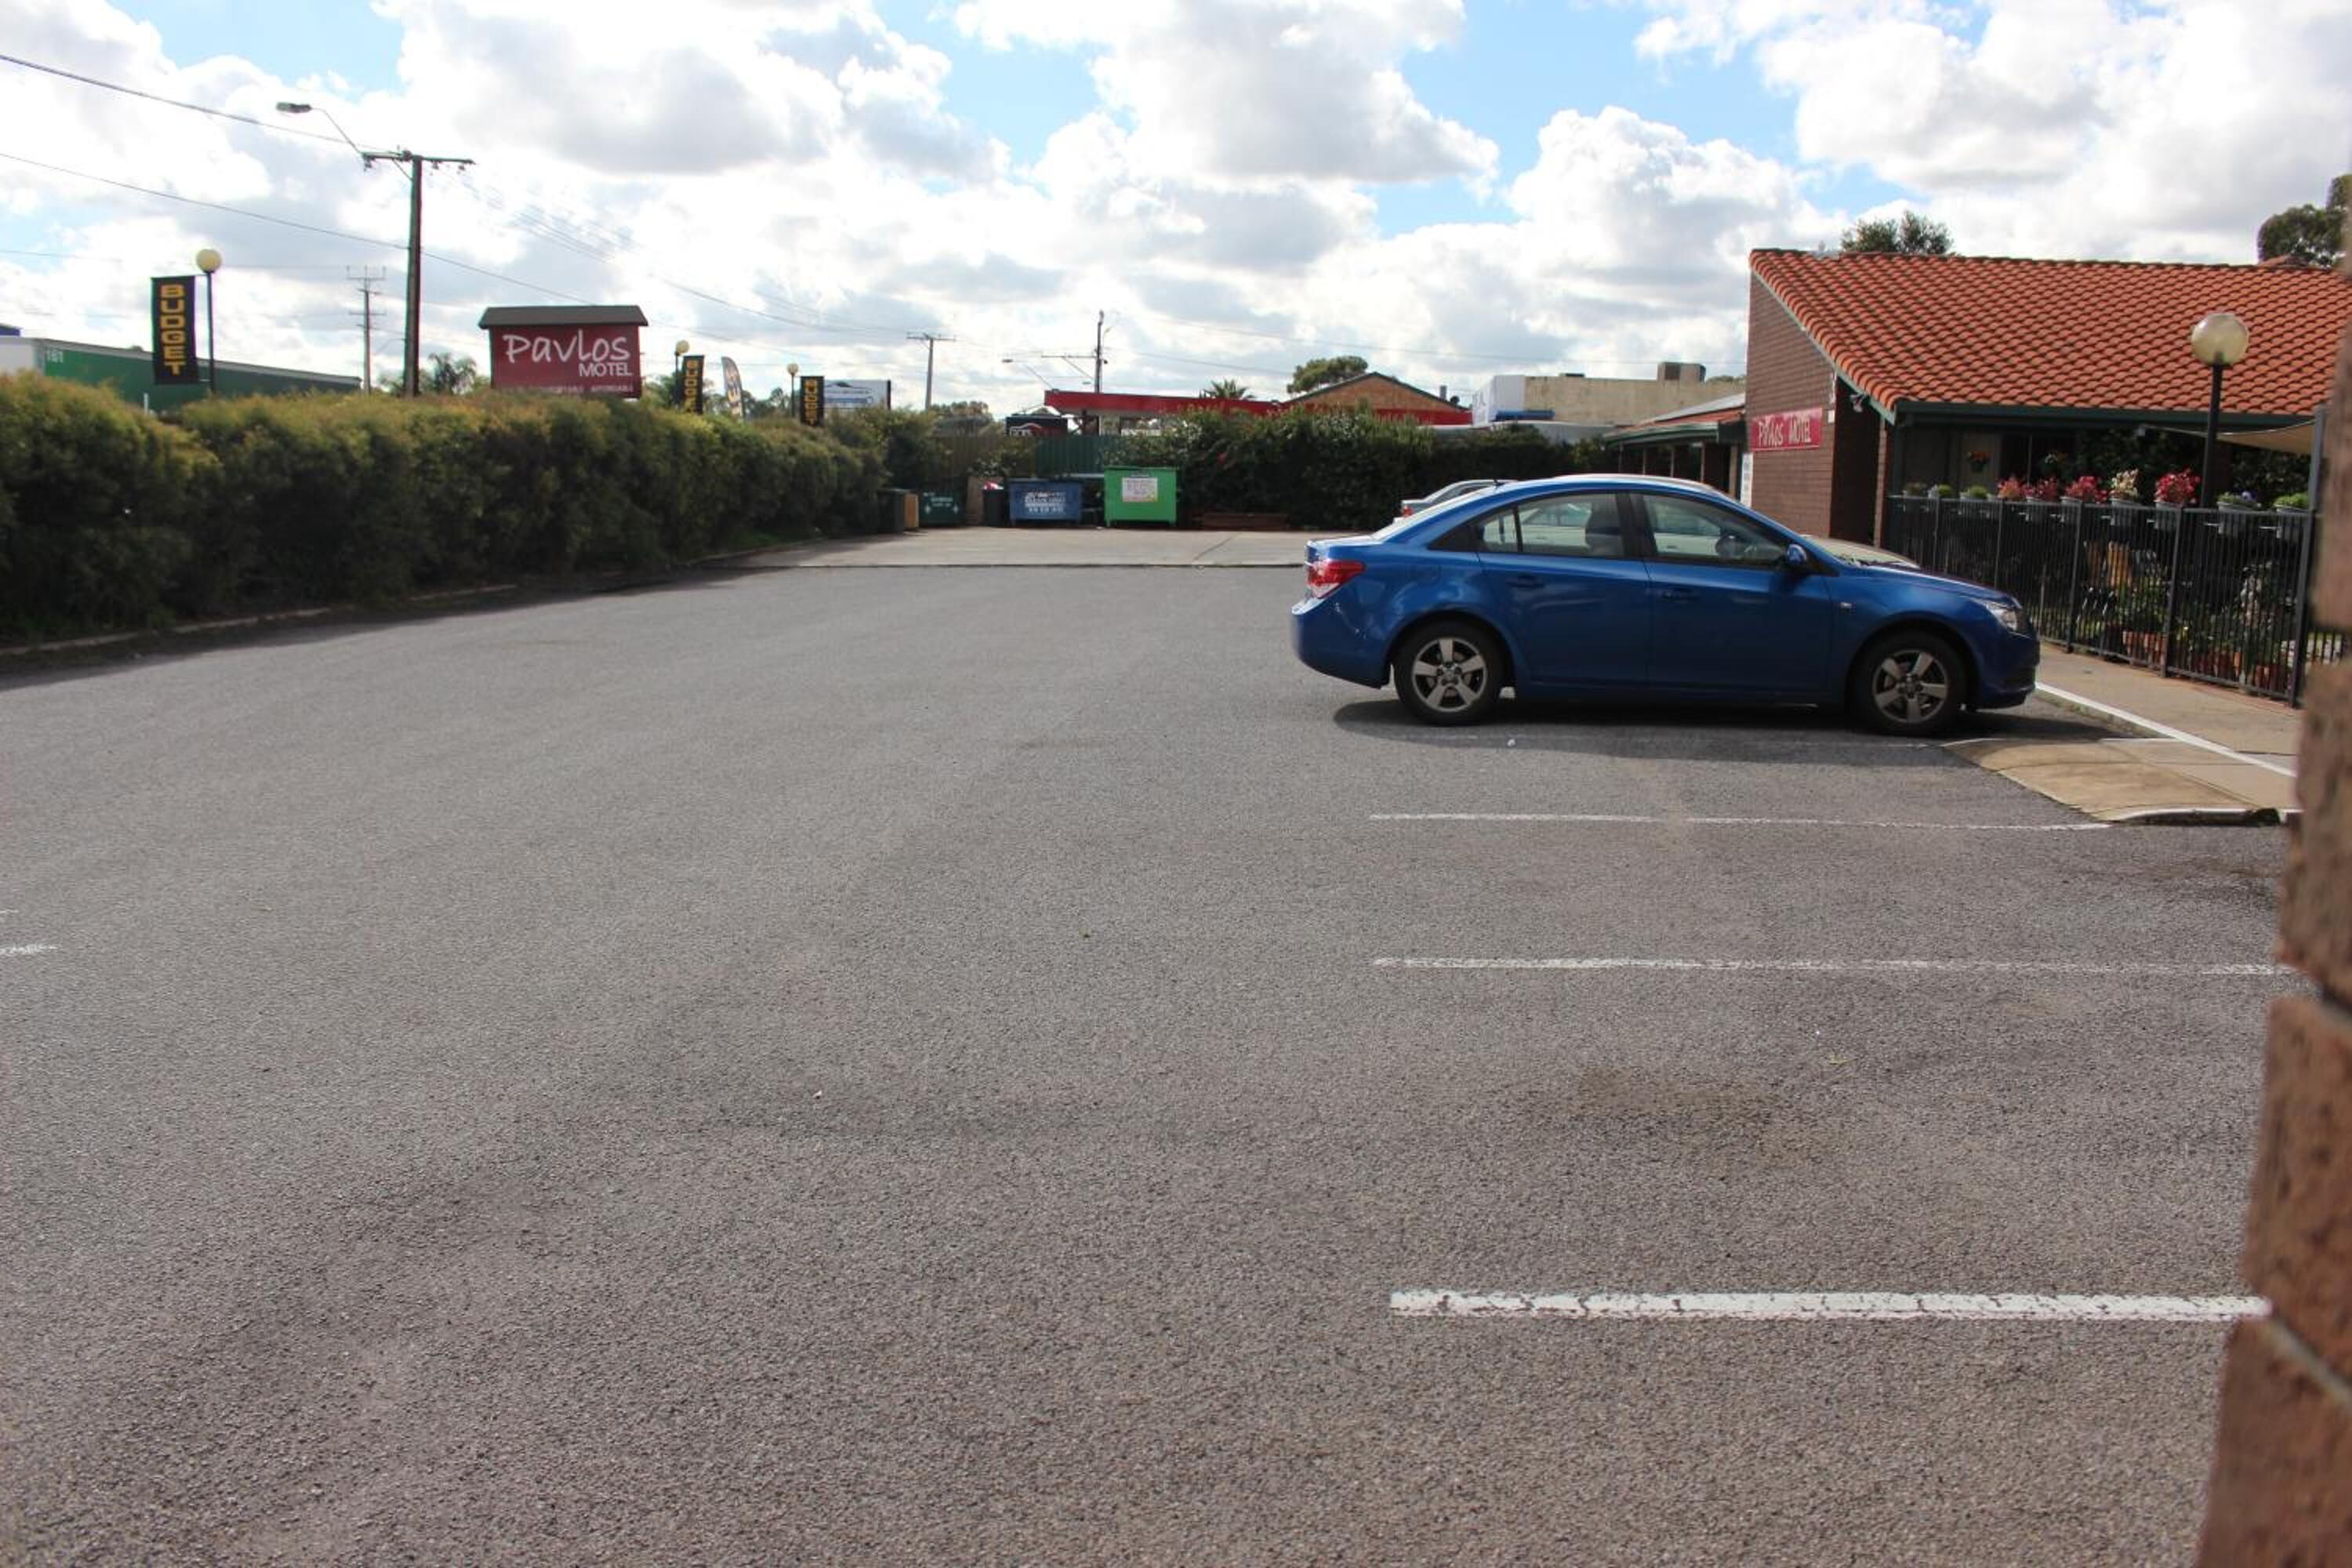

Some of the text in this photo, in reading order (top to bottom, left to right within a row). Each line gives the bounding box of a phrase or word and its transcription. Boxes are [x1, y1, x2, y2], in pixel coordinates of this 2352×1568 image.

[161, 284, 186, 376] BUDGET
[501, 329, 630, 363] Pavlos
[579, 363, 633, 376] MOTEL
